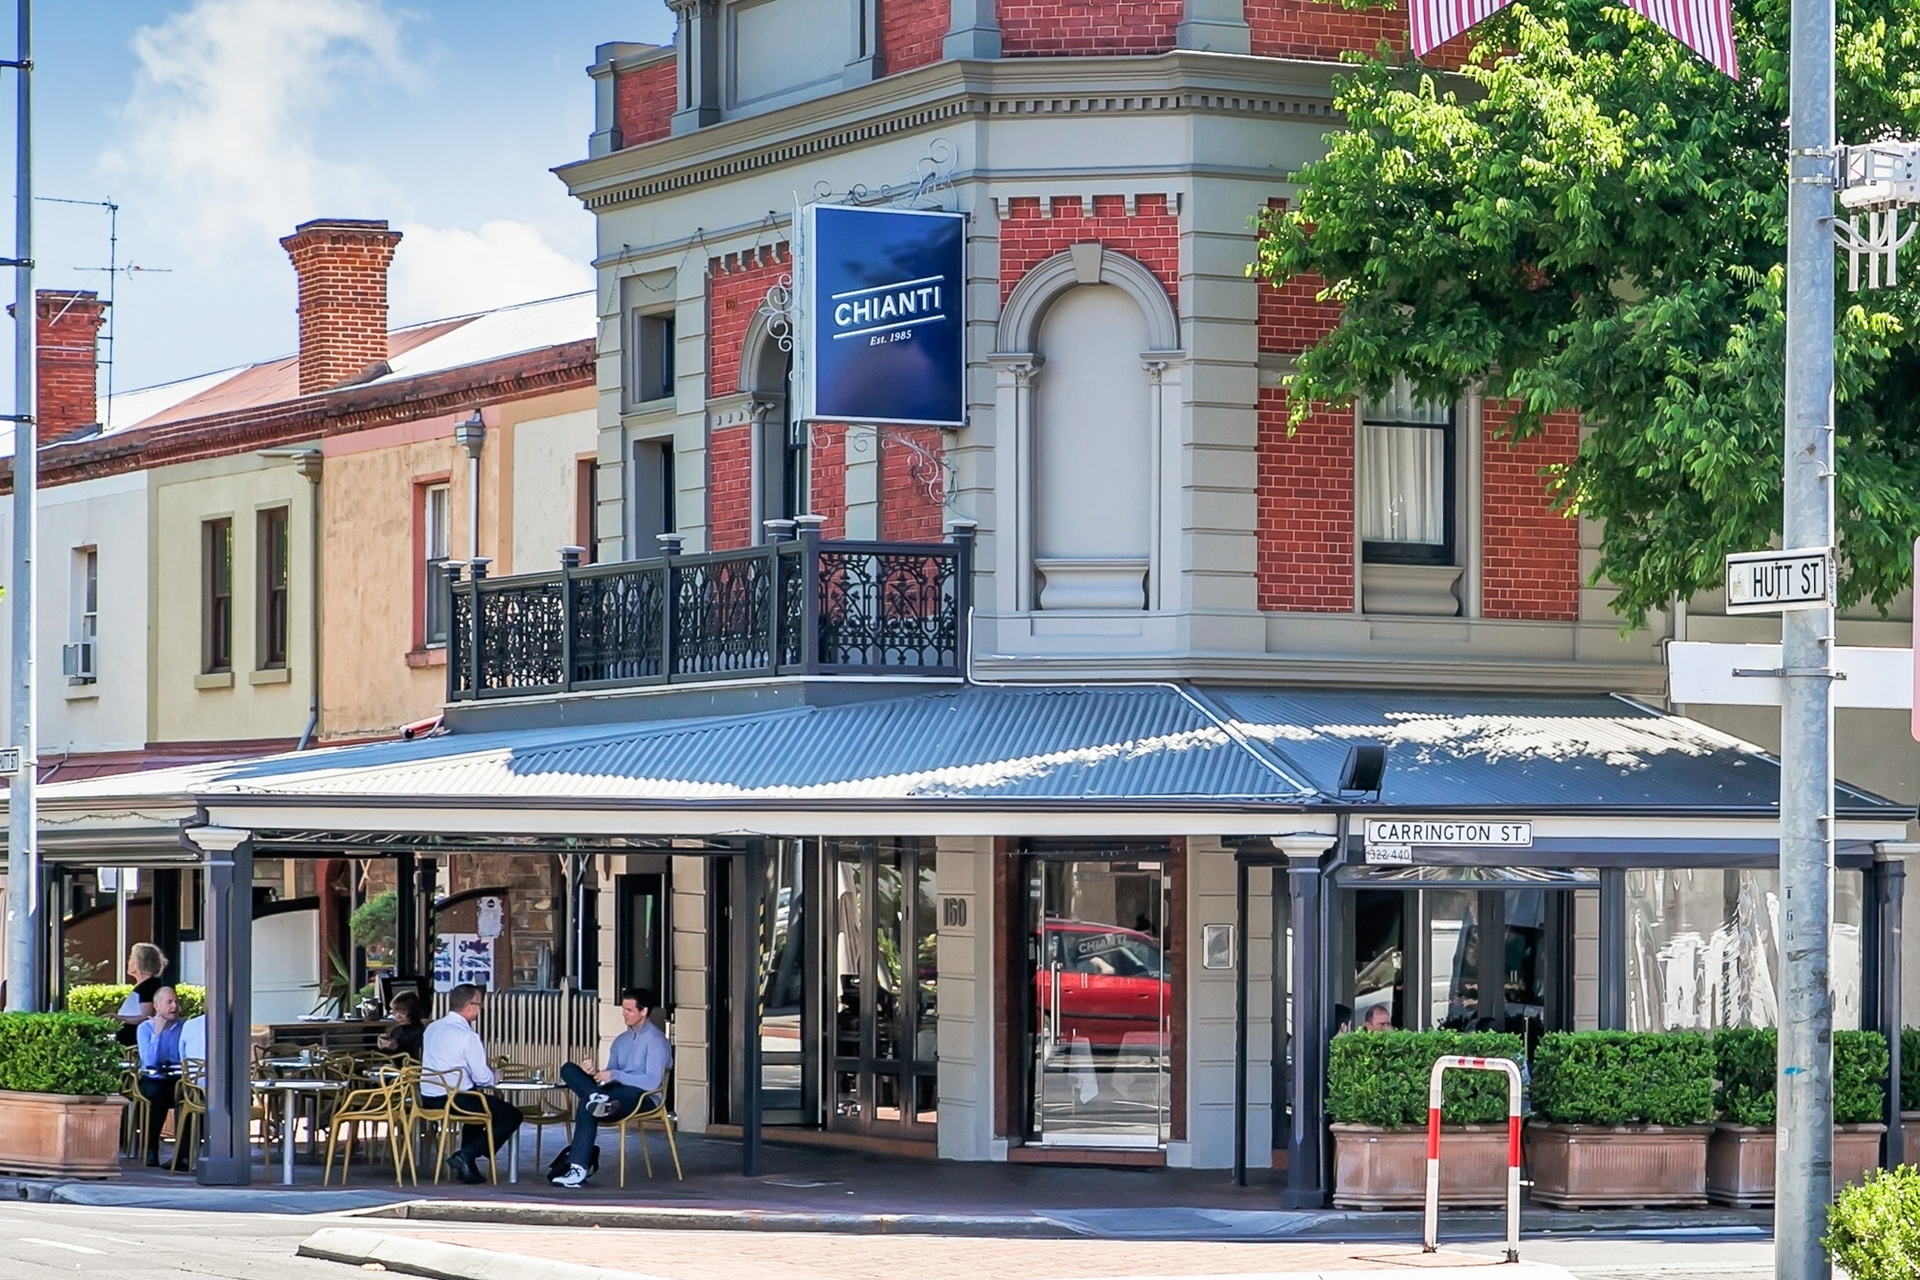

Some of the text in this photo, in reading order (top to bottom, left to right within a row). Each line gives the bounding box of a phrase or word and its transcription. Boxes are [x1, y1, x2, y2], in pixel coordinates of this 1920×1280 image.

[834, 286, 941, 326] CHIANTI
[870, 329, 912, 346] Est. 1985
[1753, 563, 1819, 597] HUTT ST
[1377, 824, 1526, 841] CARRINGTON ST.
[943, 897, 967, 927] 160
